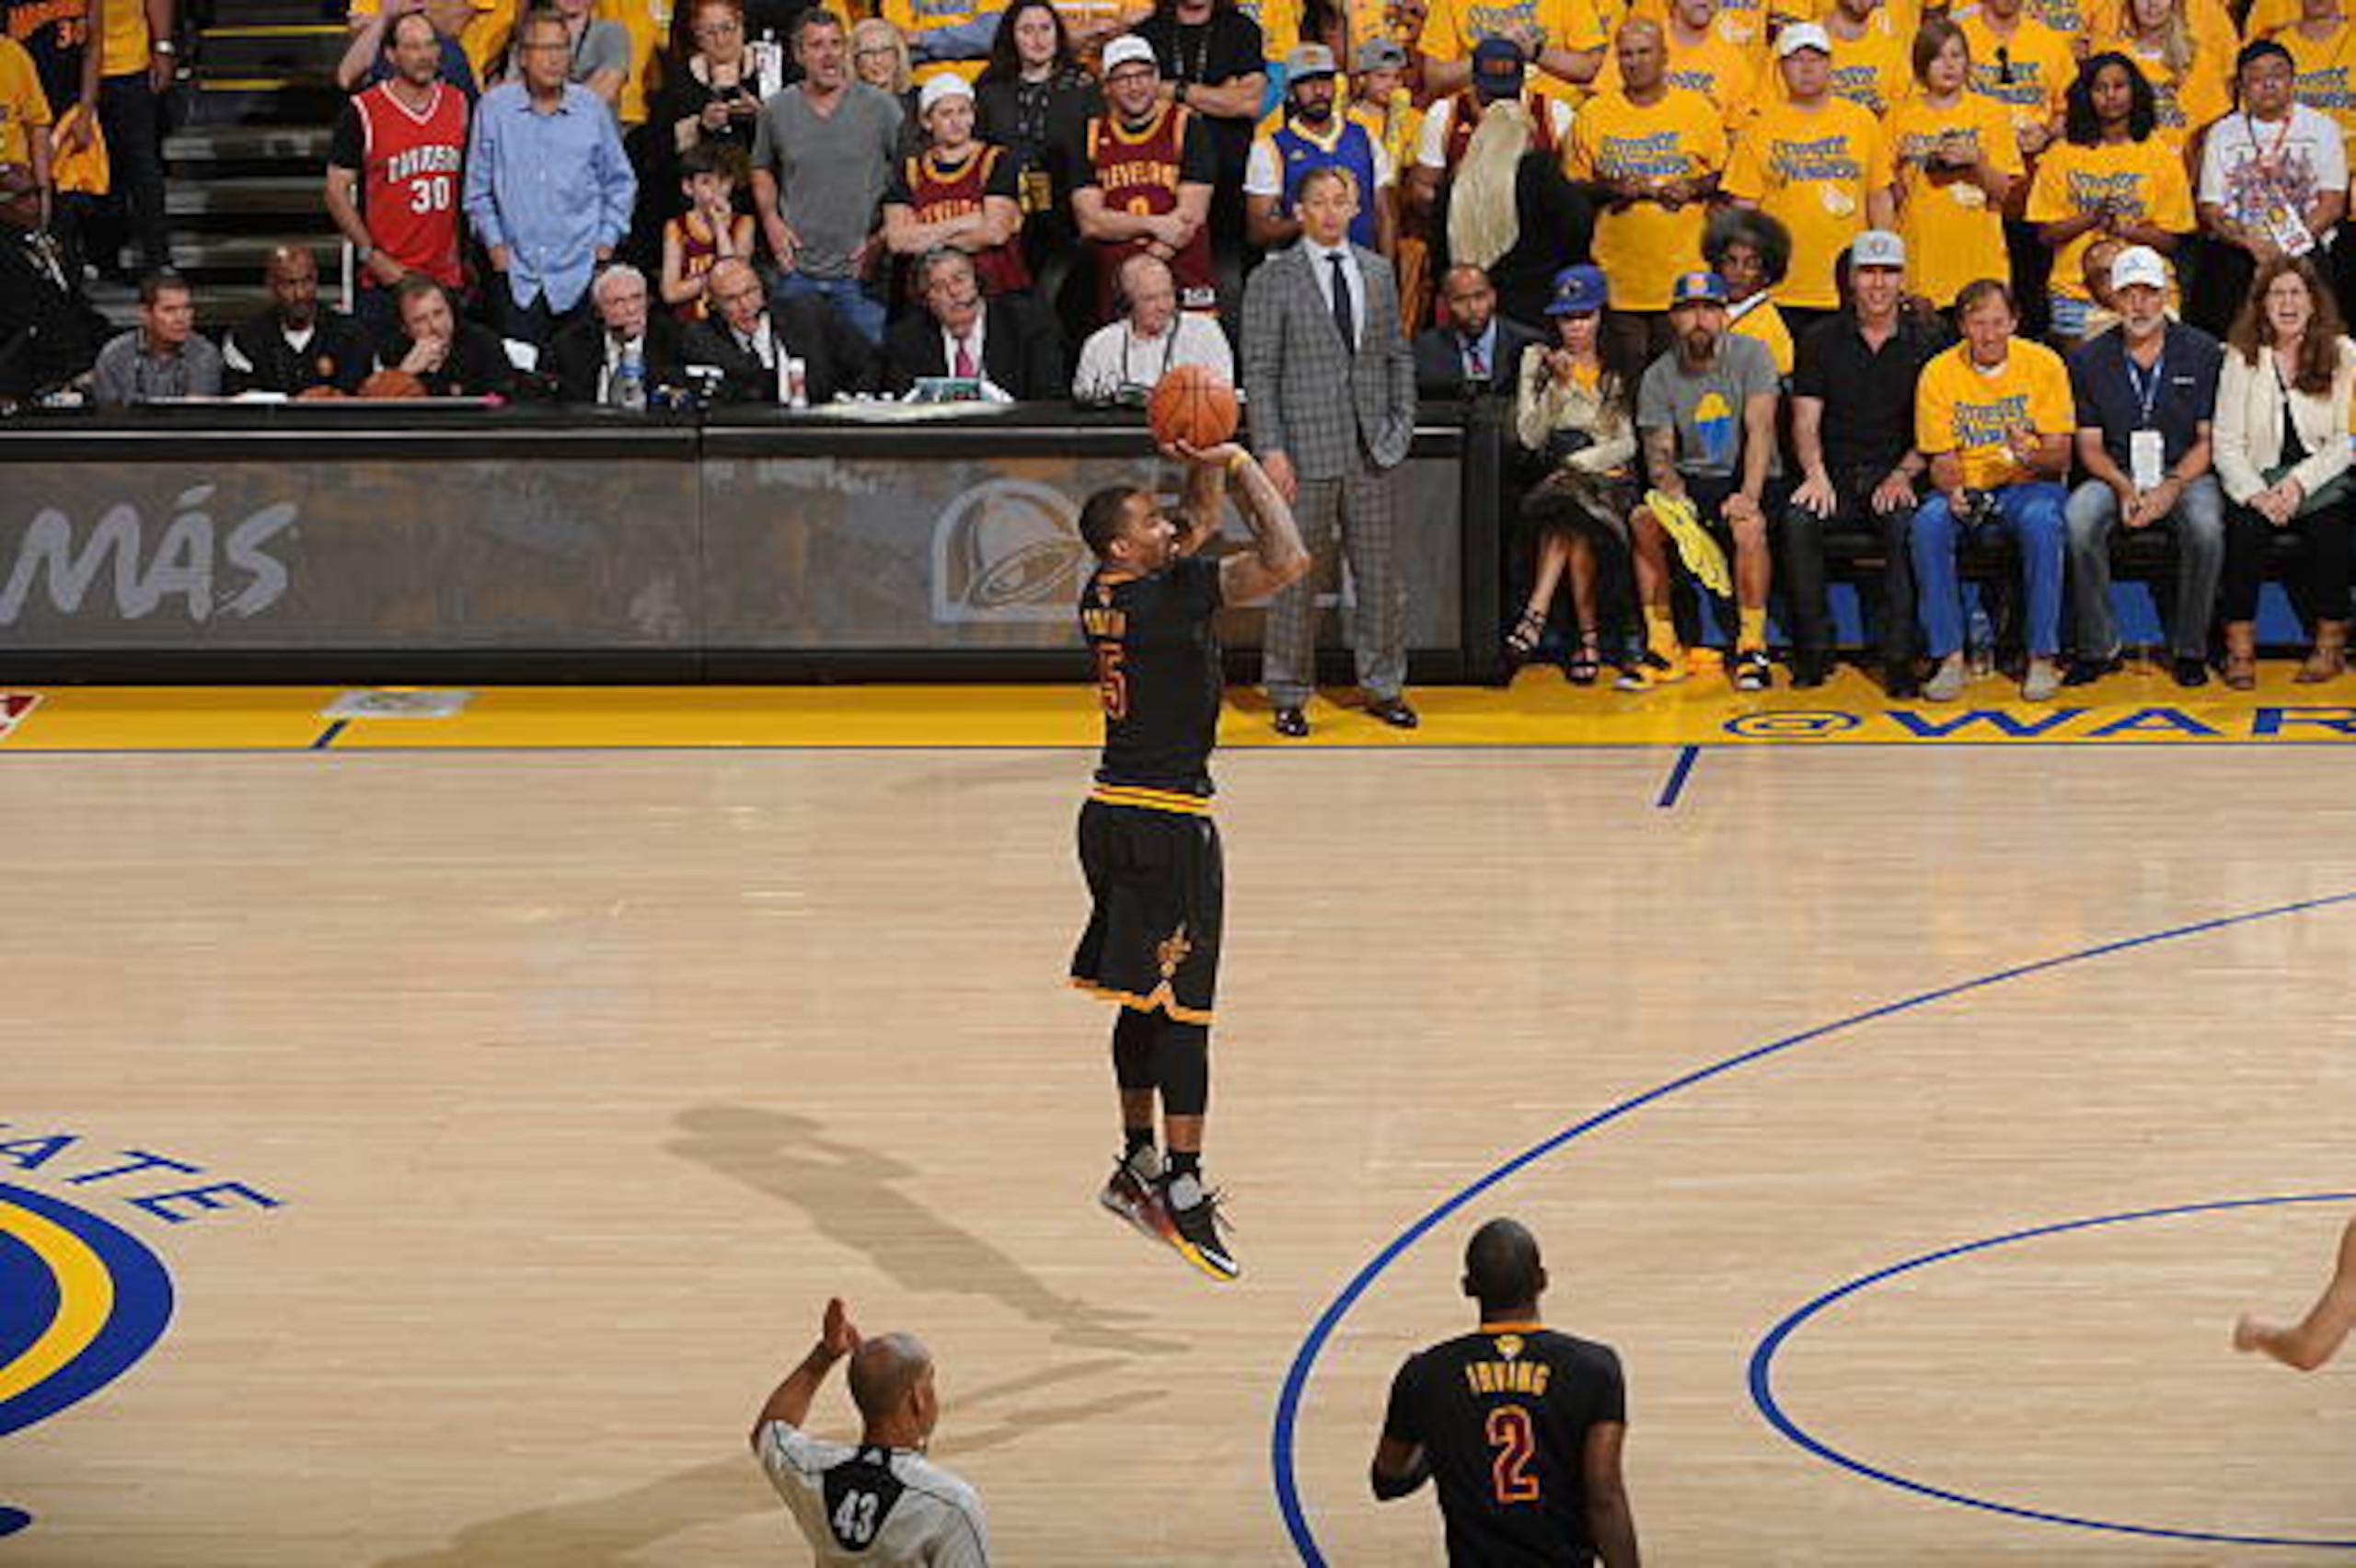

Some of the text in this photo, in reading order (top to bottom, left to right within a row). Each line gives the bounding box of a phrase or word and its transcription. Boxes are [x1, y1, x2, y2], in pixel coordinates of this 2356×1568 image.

[410, 176, 450, 214] 30
[0, 483, 299, 625] MÁS
[0, 1123, 285, 1224] ATE
[1484, 1402, 1540, 1505] 2
[832, 1488, 879, 1544] 43
